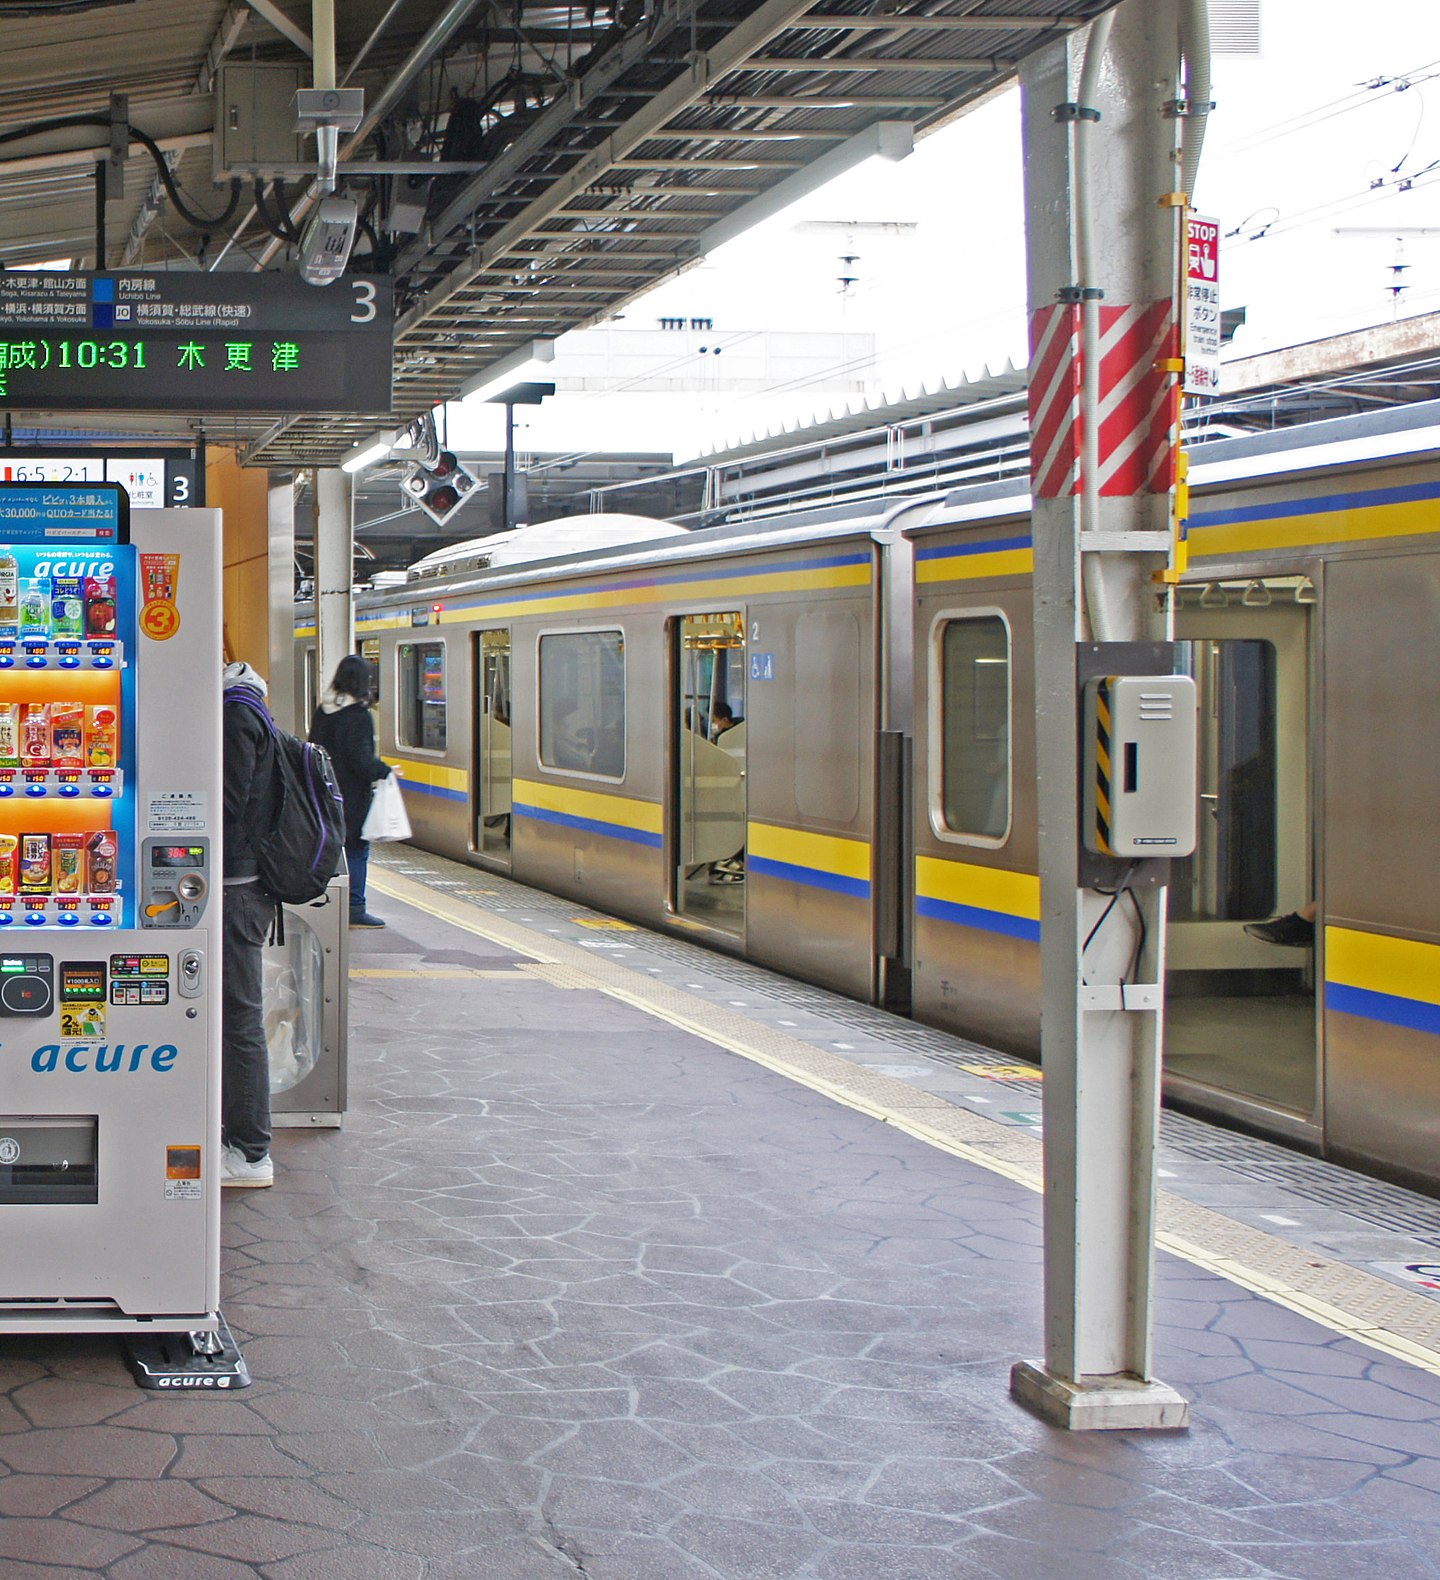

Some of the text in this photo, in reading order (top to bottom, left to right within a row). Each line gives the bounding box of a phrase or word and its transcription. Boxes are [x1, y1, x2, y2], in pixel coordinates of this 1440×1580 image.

[1187, 223, 1217, 242] STOP
[118, 279, 156, 292] 内房線
[20, 290, 48, 298] Kisarazu
[48, 290, 55, 298] &
[55, 290, 87, 299] Tateyama
[145, 292, 161, 301] Line
[350, 281, 377, 324] 3
[16, 315, 49, 323] Yokohama
[49, 315, 56, 323] &
[56, 315, 87, 324] Yokosuka
[116, 305, 130, 320] JO
[1193, 307, 1217, 323] ボタン
[195, 318, 211, 327] Line
[212, 318, 239, 328] (Rapid)
[59, 341, 147, 370] 10:31
[173, 476, 189, 501] 3
[33, 561, 115, 578] acure
[146, 606, 171, 633] 3
[751, 622, 759, 641] 2
[30, 1043, 179, 1073] acure
[158, 1376, 215, 1387] acure
